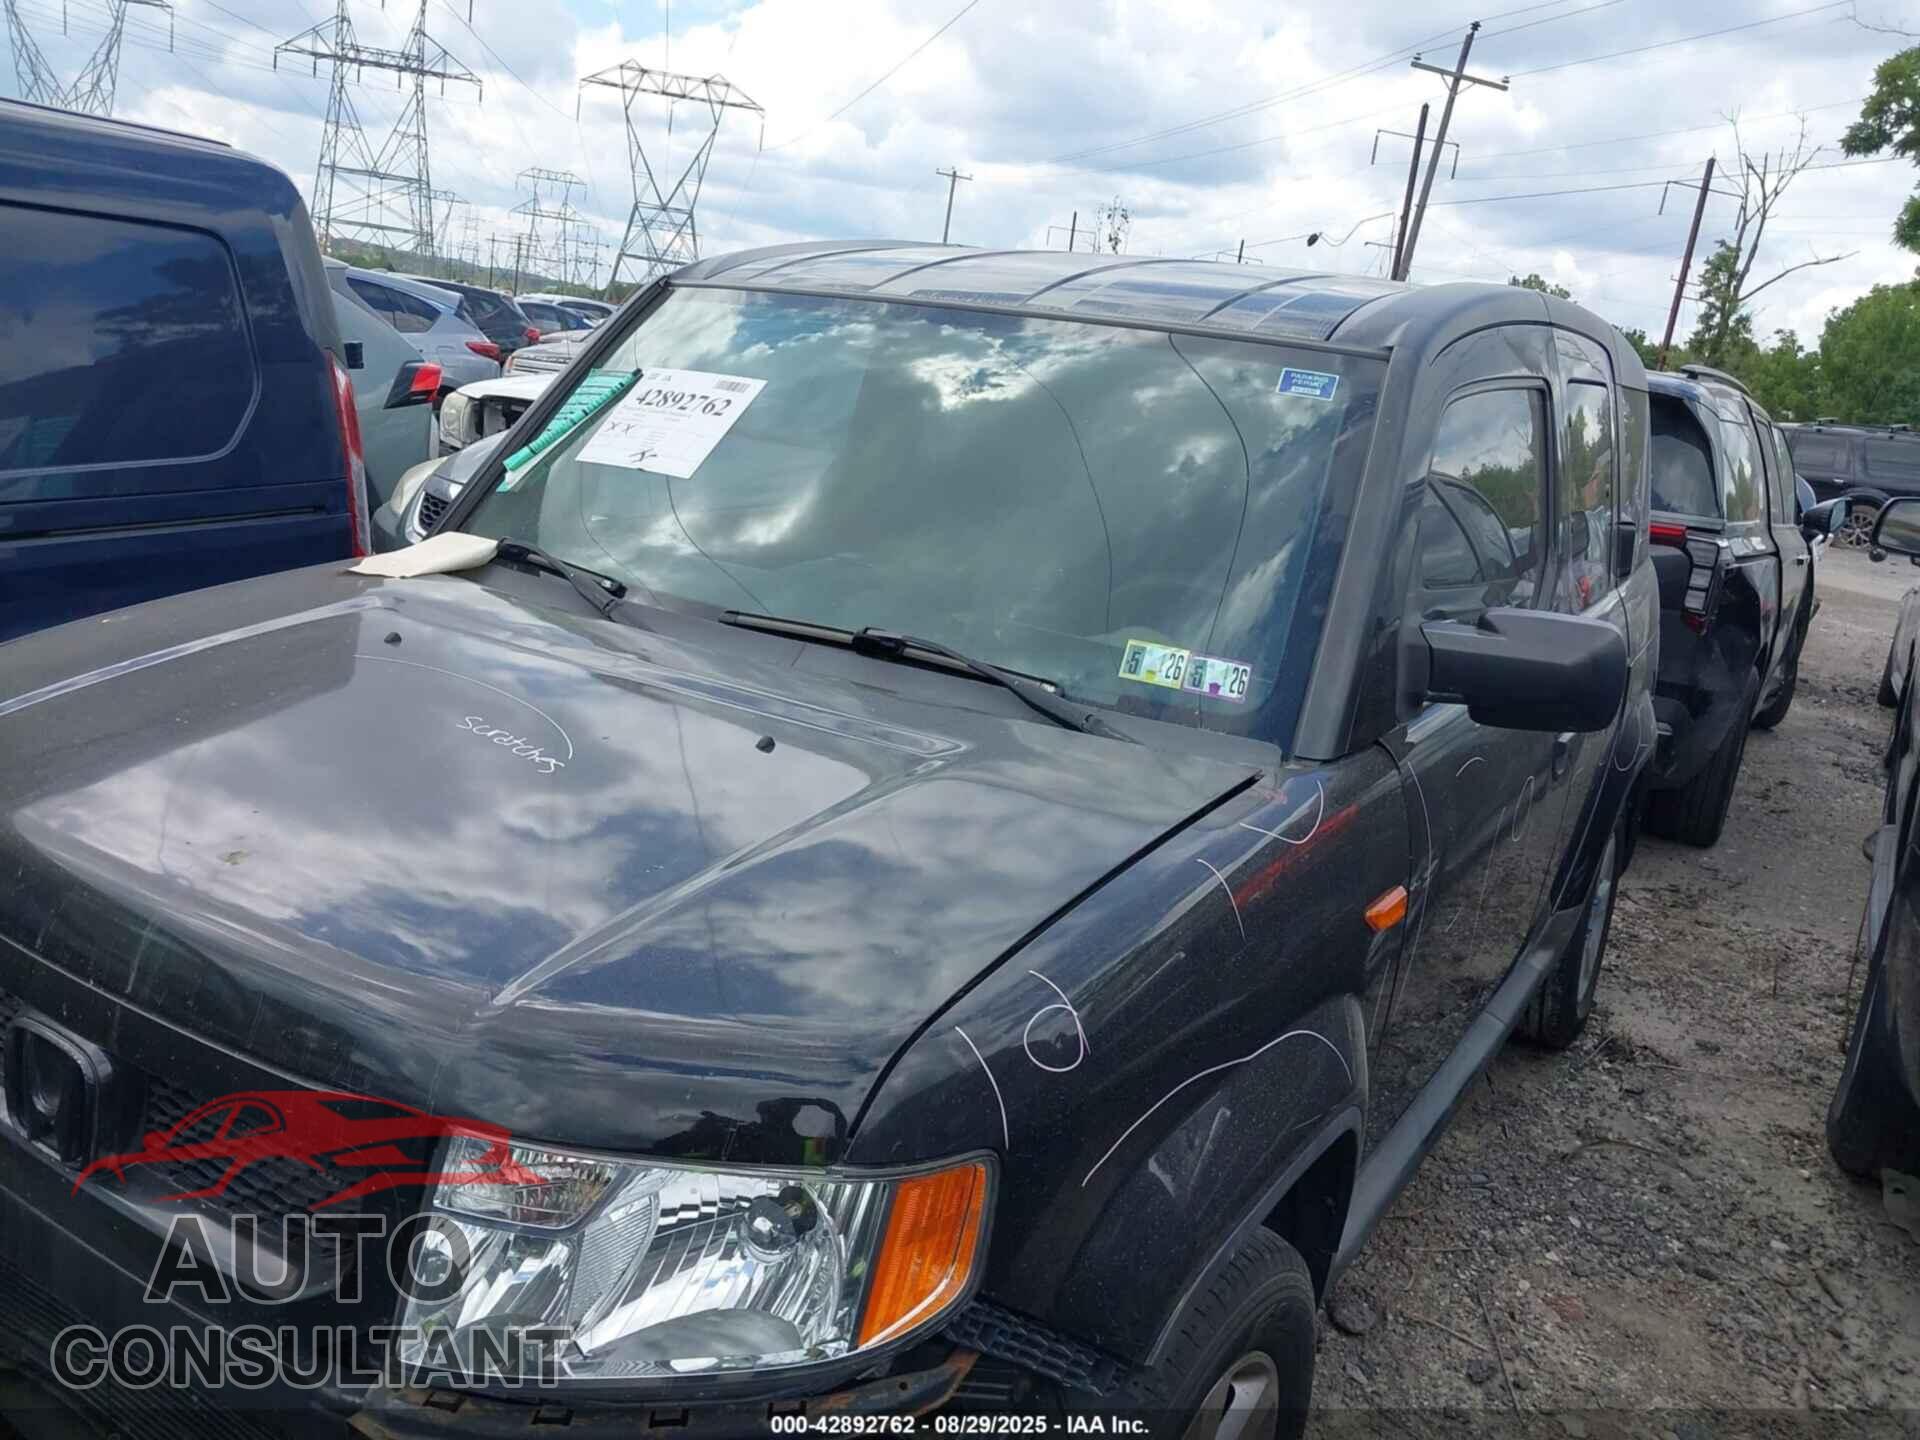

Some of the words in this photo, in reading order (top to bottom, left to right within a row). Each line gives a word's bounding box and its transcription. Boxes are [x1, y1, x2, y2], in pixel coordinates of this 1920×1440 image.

[636, 388, 732, 417] 42892762
[1164, 653, 1185, 681] 26
[1228, 667, 1249, 695] 26
